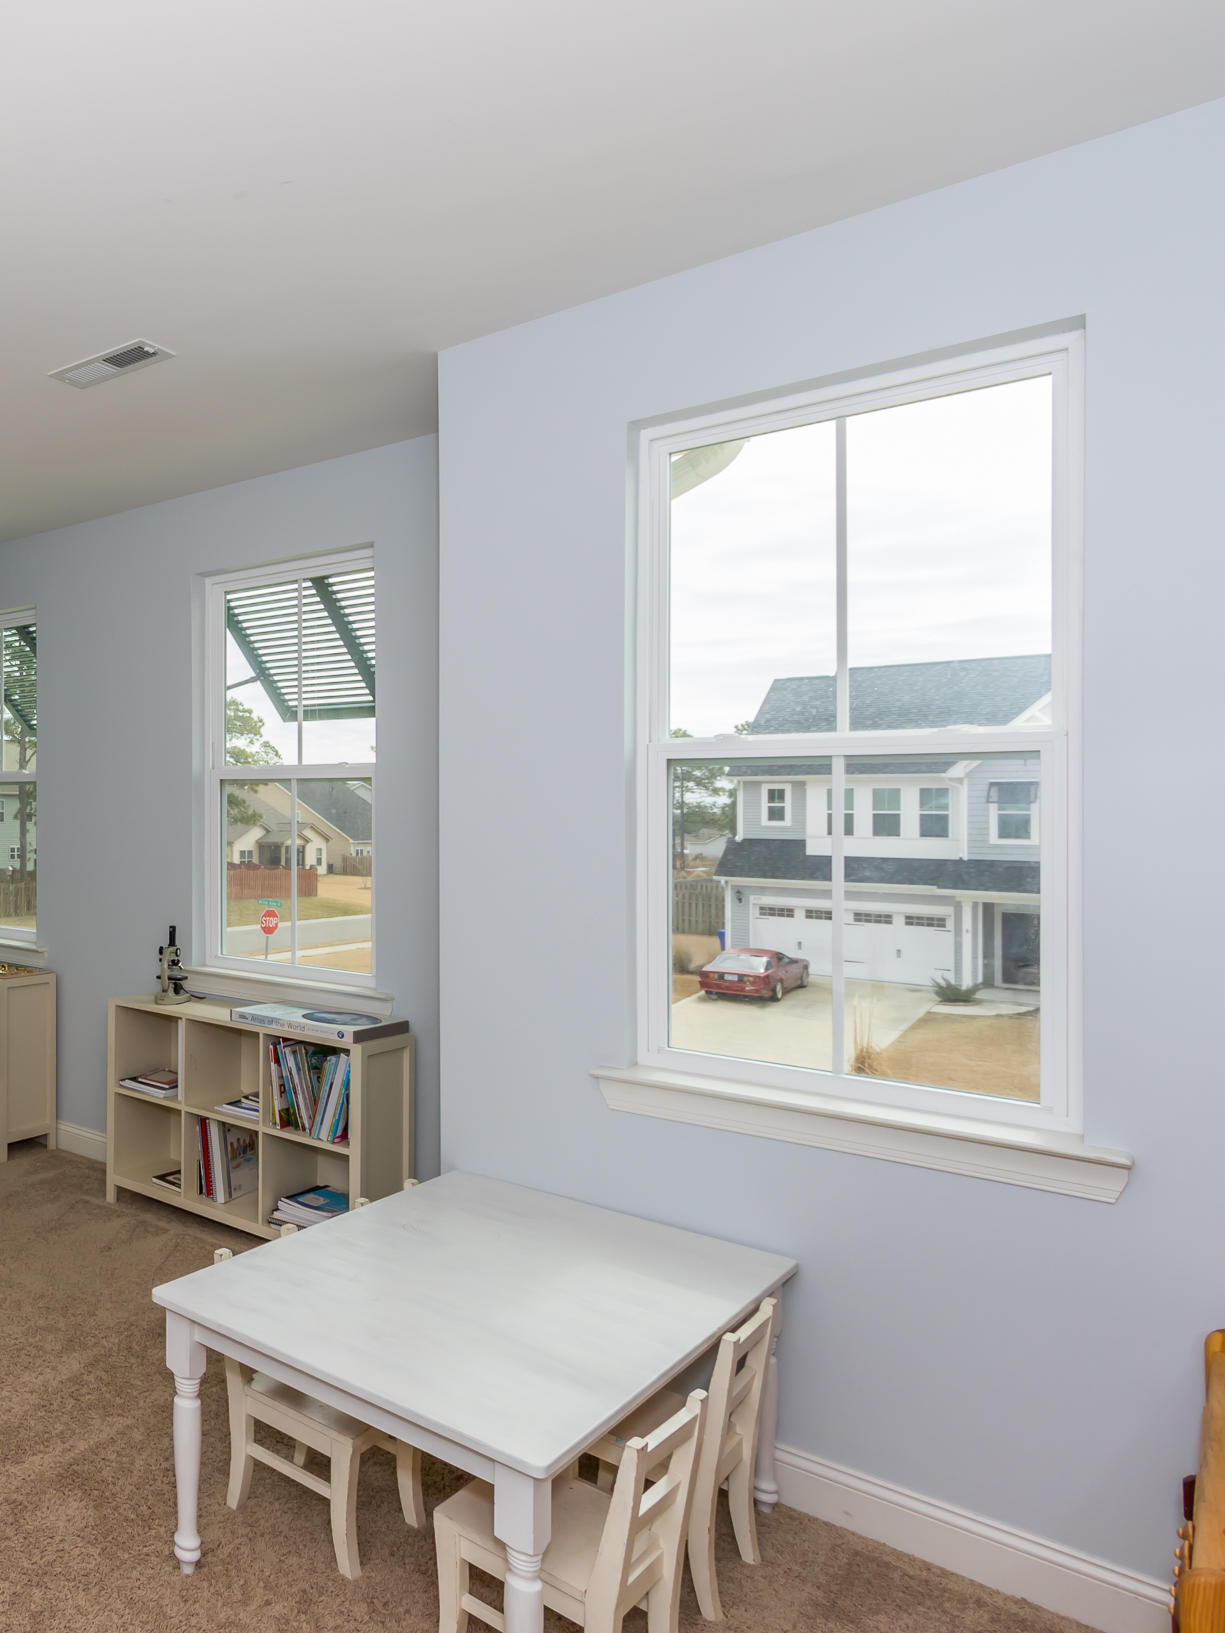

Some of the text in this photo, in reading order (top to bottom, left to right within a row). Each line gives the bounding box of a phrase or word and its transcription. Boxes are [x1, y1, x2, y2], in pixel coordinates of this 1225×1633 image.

[261, 917, 278, 927] STOP
[250, 1015, 266, 1025] Atlas
[267, 1017, 274, 1026] of
[275, 1019, 285, 1028] the
[287, 1022, 306, 1032] World
